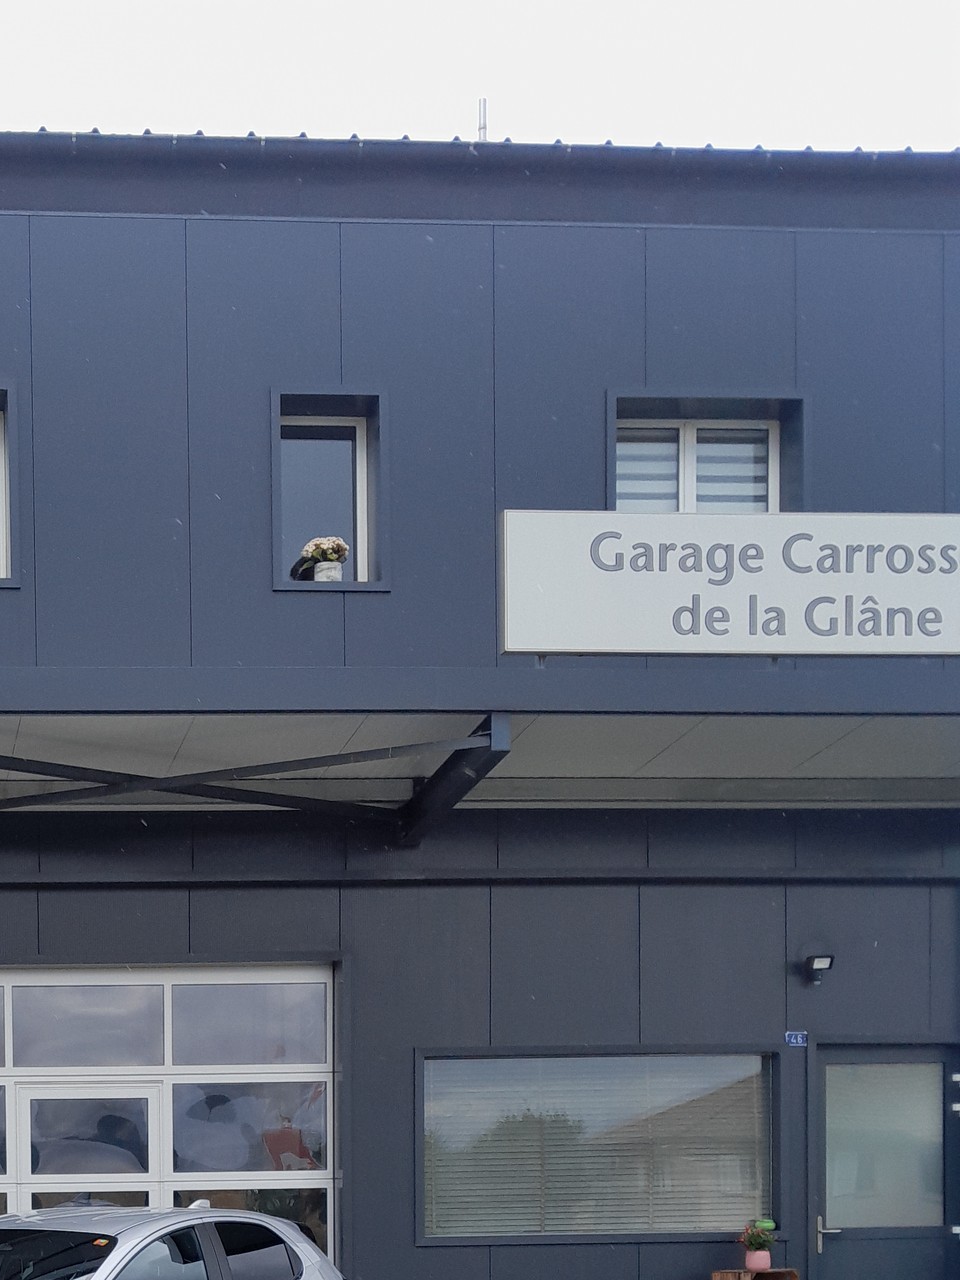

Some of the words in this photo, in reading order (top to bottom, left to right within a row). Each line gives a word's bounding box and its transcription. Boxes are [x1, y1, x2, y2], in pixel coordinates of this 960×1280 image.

[589, 530, 765, 587] Garage
[781, 532, 959, 575] Carross
[672, 594, 730, 637] de
[748, 594, 787, 637] la
[803, 594, 943, 638] Glâne
